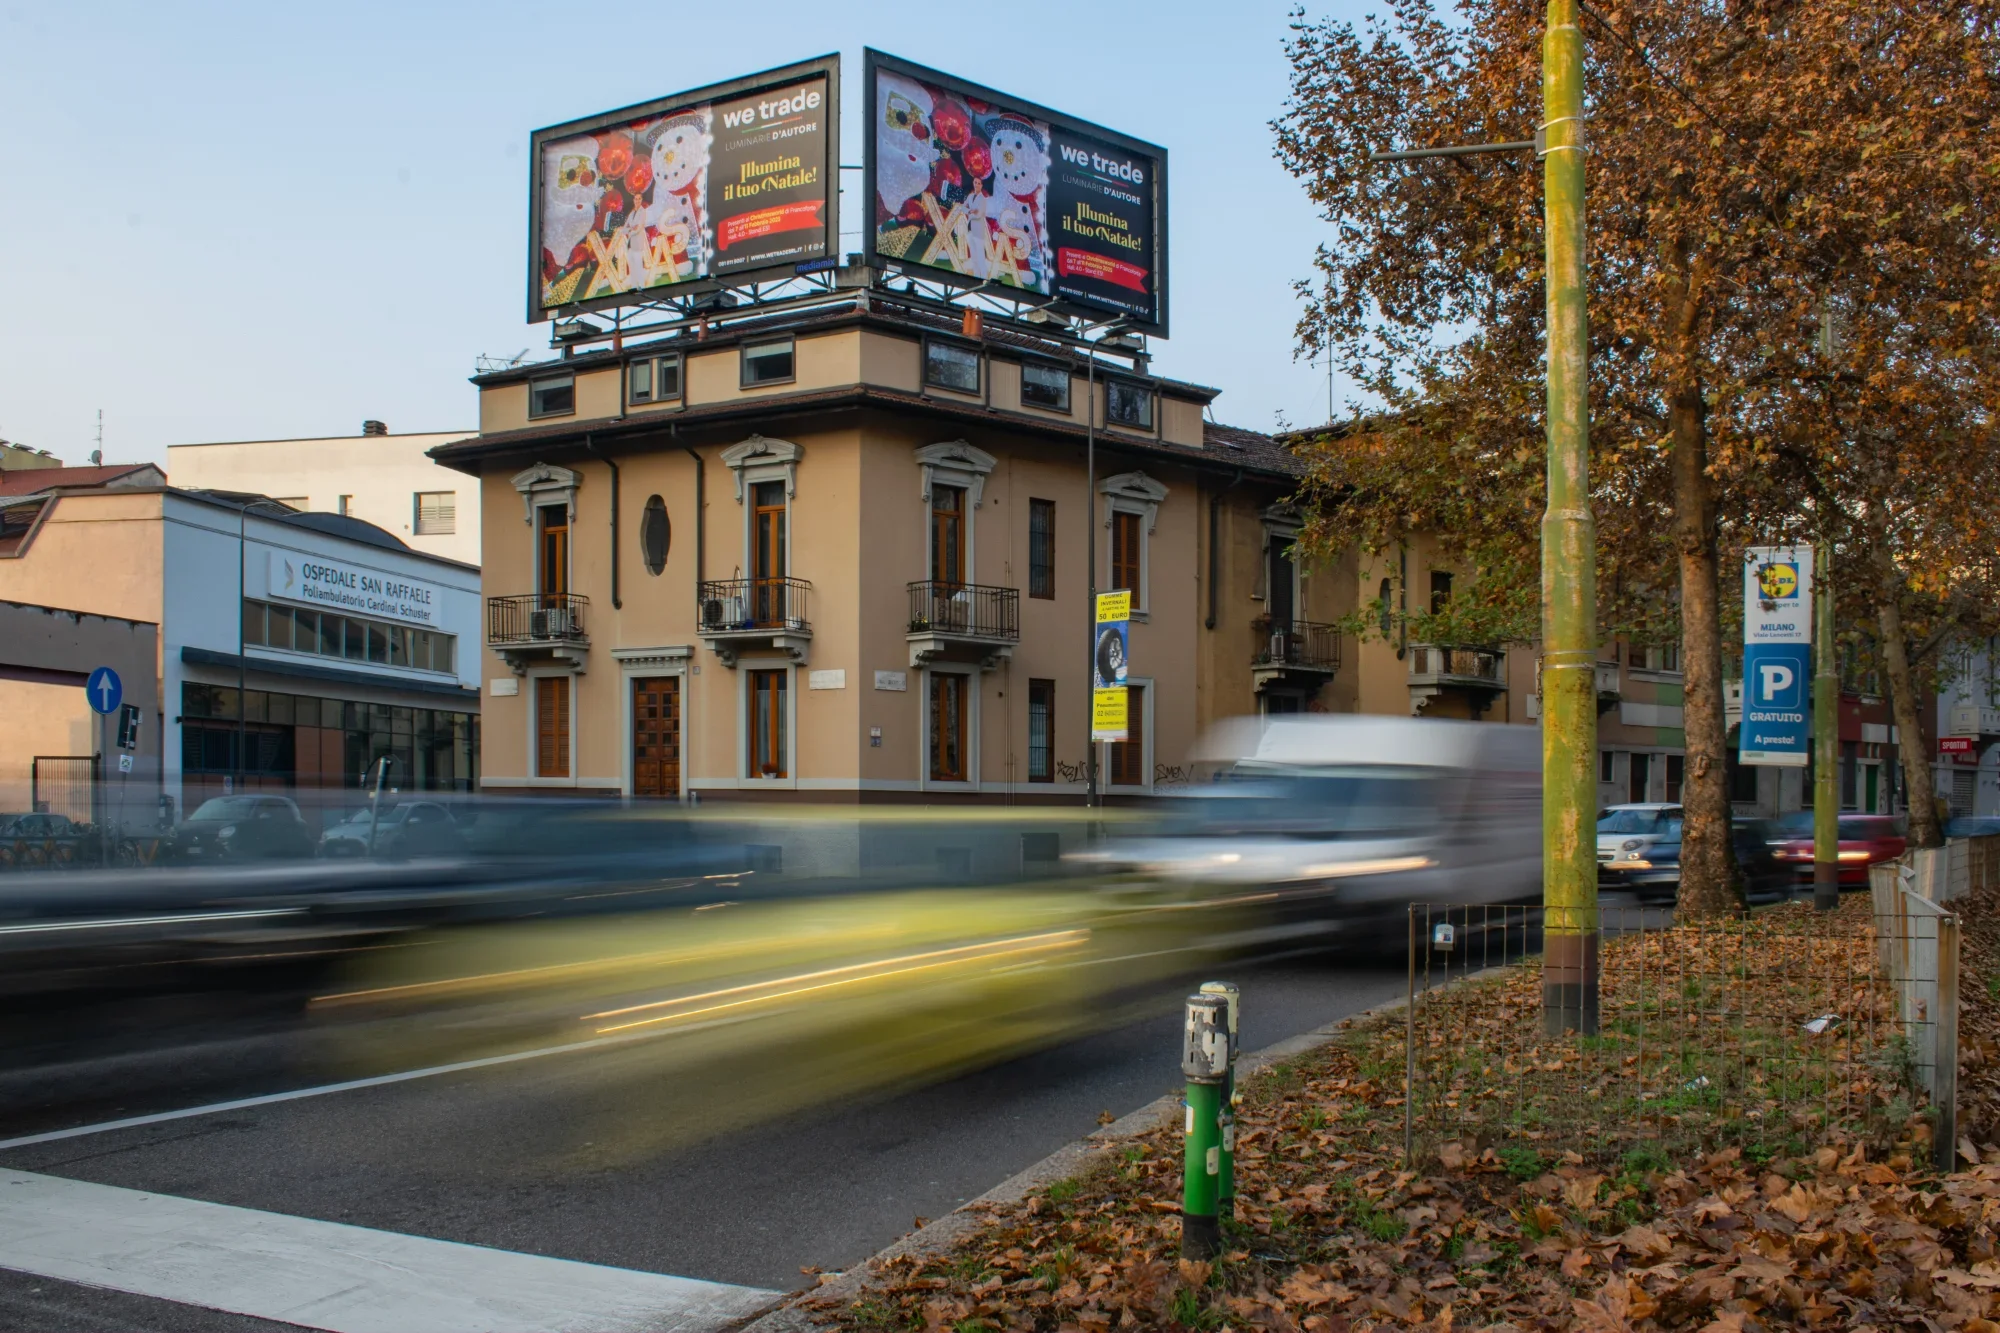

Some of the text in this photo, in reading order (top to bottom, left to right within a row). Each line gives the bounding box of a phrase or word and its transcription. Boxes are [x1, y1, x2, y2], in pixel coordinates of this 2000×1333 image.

[723, 89, 820, 128] we trade
[725, 122, 817, 151] LUMINARIE D'AUTORE
[741, 153, 801, 183] Illumina
[1060, 144, 1144, 184] we trade
[724, 166, 817, 201] il tuo Natale!
[1062, 173, 1141, 205] LUMINARIE D'AUTORE
[1077, 202, 1128, 230] Illumina
[1062, 215, 1142, 251] il tuo Natale!
[796, 258, 836, 273] mediamix
[303, 563, 431, 604] OSPEDALE SAN RAFFAELE
[303, 584, 431, 620] Poliambulatorio Cardinal Schuster
[1101, 599, 1127, 607] INVERNALI
[1111, 611, 1128, 619] EURO
[1760, 623, 1796, 632] MILANO
[1760, 665, 1794, 701] P
[1749, 712, 1803, 723] GRATUITO
[1754, 734, 1796, 746] A presto!
